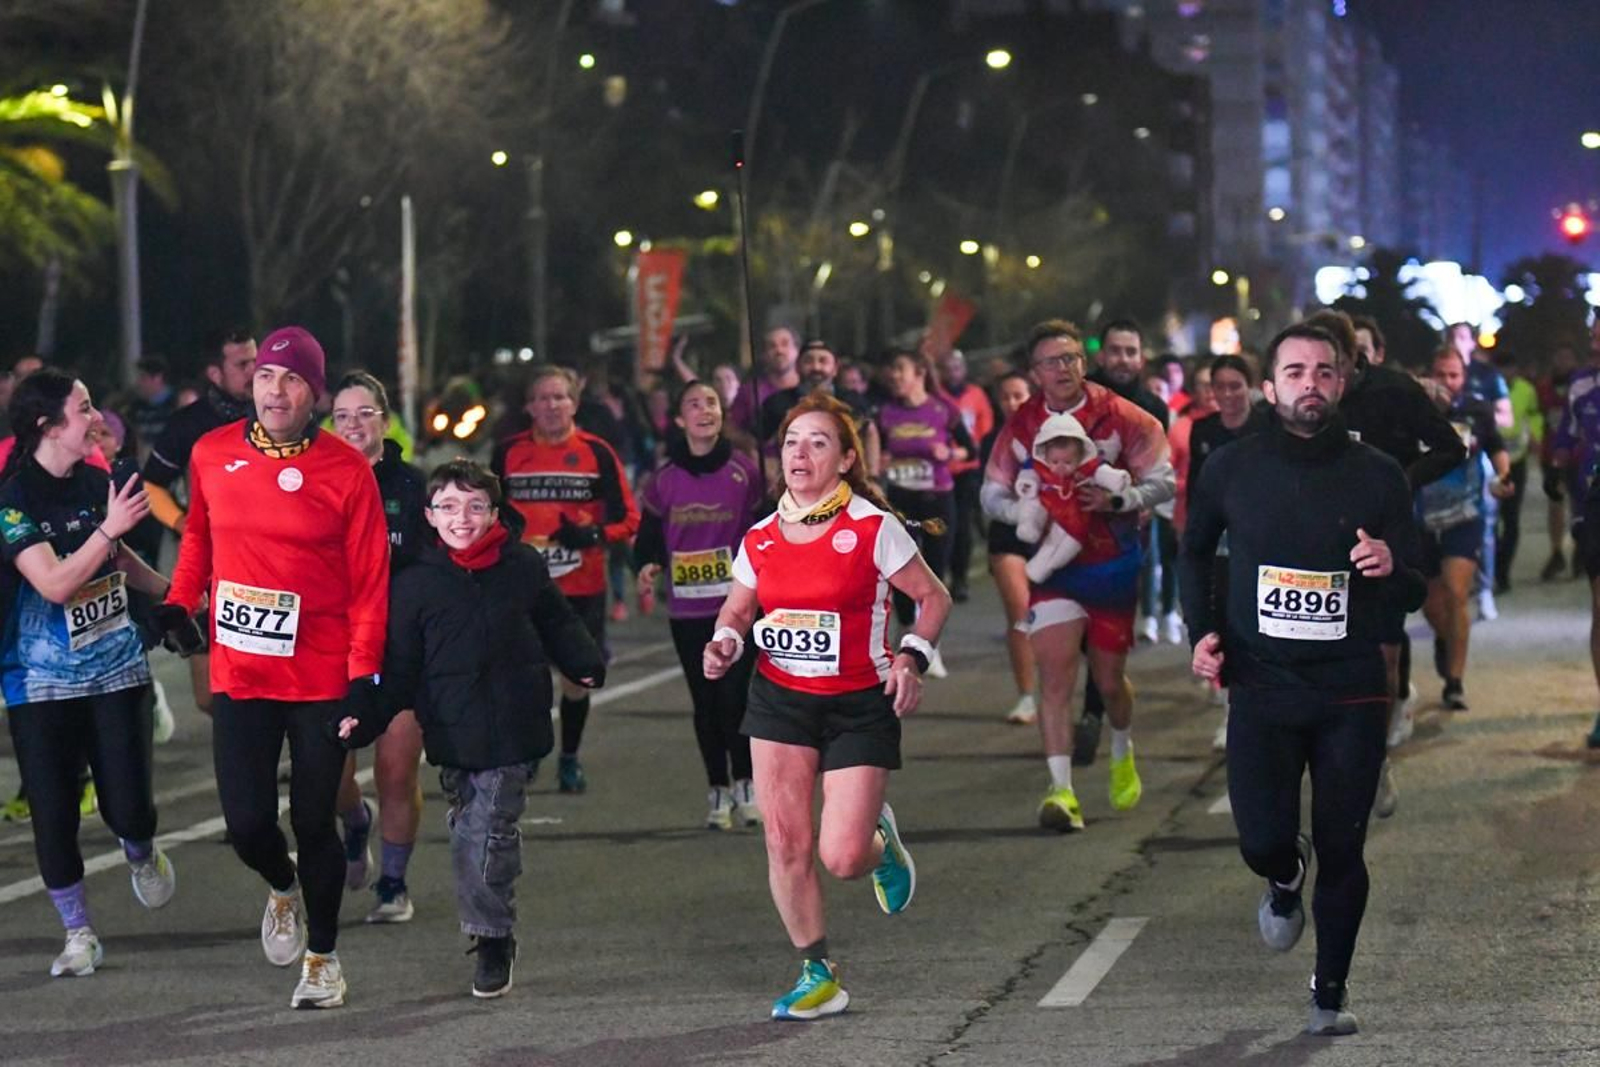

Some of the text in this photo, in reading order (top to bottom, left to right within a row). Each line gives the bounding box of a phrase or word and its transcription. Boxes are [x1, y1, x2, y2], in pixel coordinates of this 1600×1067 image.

[676, 561, 728, 582] 3888
[71, 589, 122, 628] 8075
[1264, 587, 1341, 614] 4896
[221, 600, 291, 632] 5677
[761, 627, 832, 653] 6039
